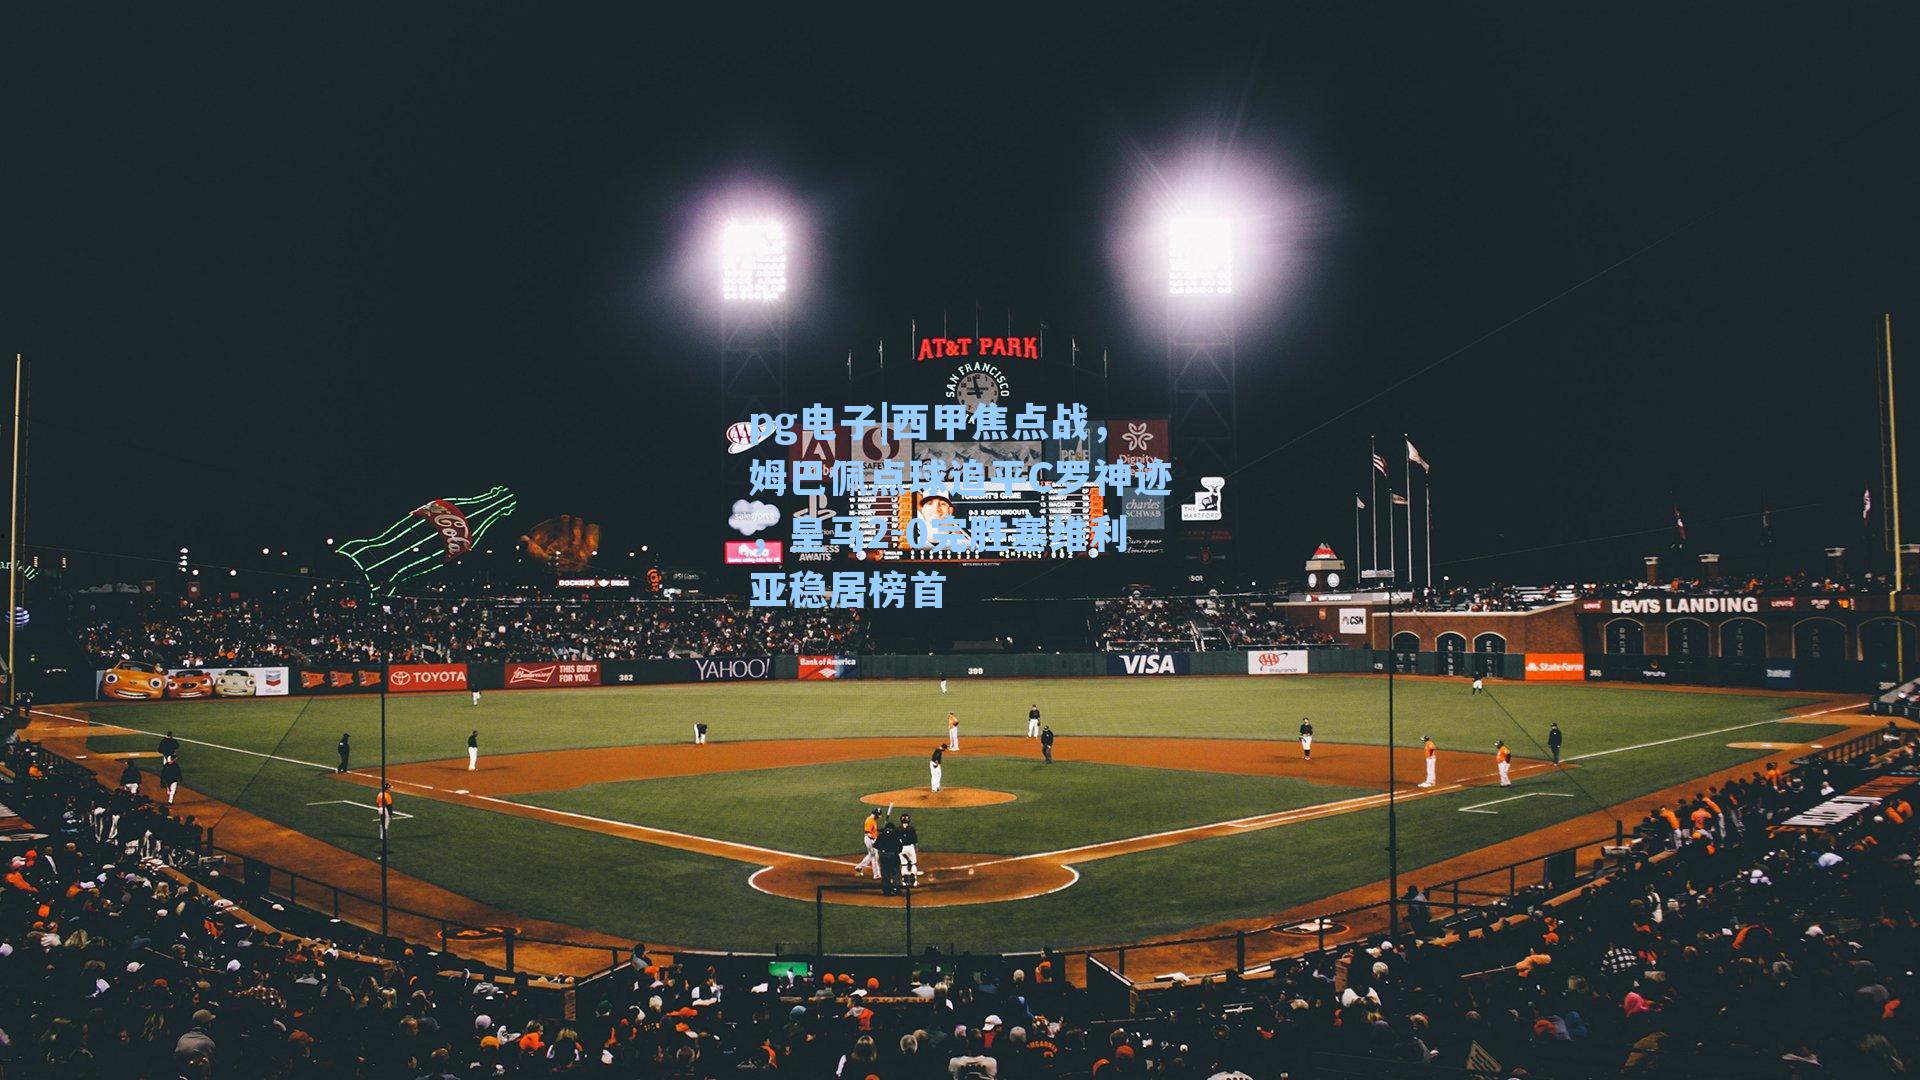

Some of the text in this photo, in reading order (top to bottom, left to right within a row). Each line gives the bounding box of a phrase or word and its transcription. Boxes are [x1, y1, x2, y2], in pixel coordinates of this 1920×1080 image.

[918, 337, 1038, 360] AT&T PARK
[945, 373, 960, 398] SAN
[957, 361, 1010, 397] FRANCISCO
[1126, 499, 1160, 510] charles
[734, 510, 775, 521] salesforce
[1126, 510, 1161, 518] SCHWAB
[799, 553, 832, 562] AWAITS
[558, 579, 630, 587] DOCKERS DECK
[1665, 597, 1759, 613] LANDING
[1350, 616, 1364, 625] CSN
[800, 658, 818, 666] Bank
[826, 658, 856, 666] America
[1118, 654, 1176, 674] VISA
[559, 664, 598, 673] THIS BUD'S
[695, 658, 771, 680] YAHOO!
[413, 671, 467, 683] TOYOTA
[559, 673, 590, 682] FOR YOU.
